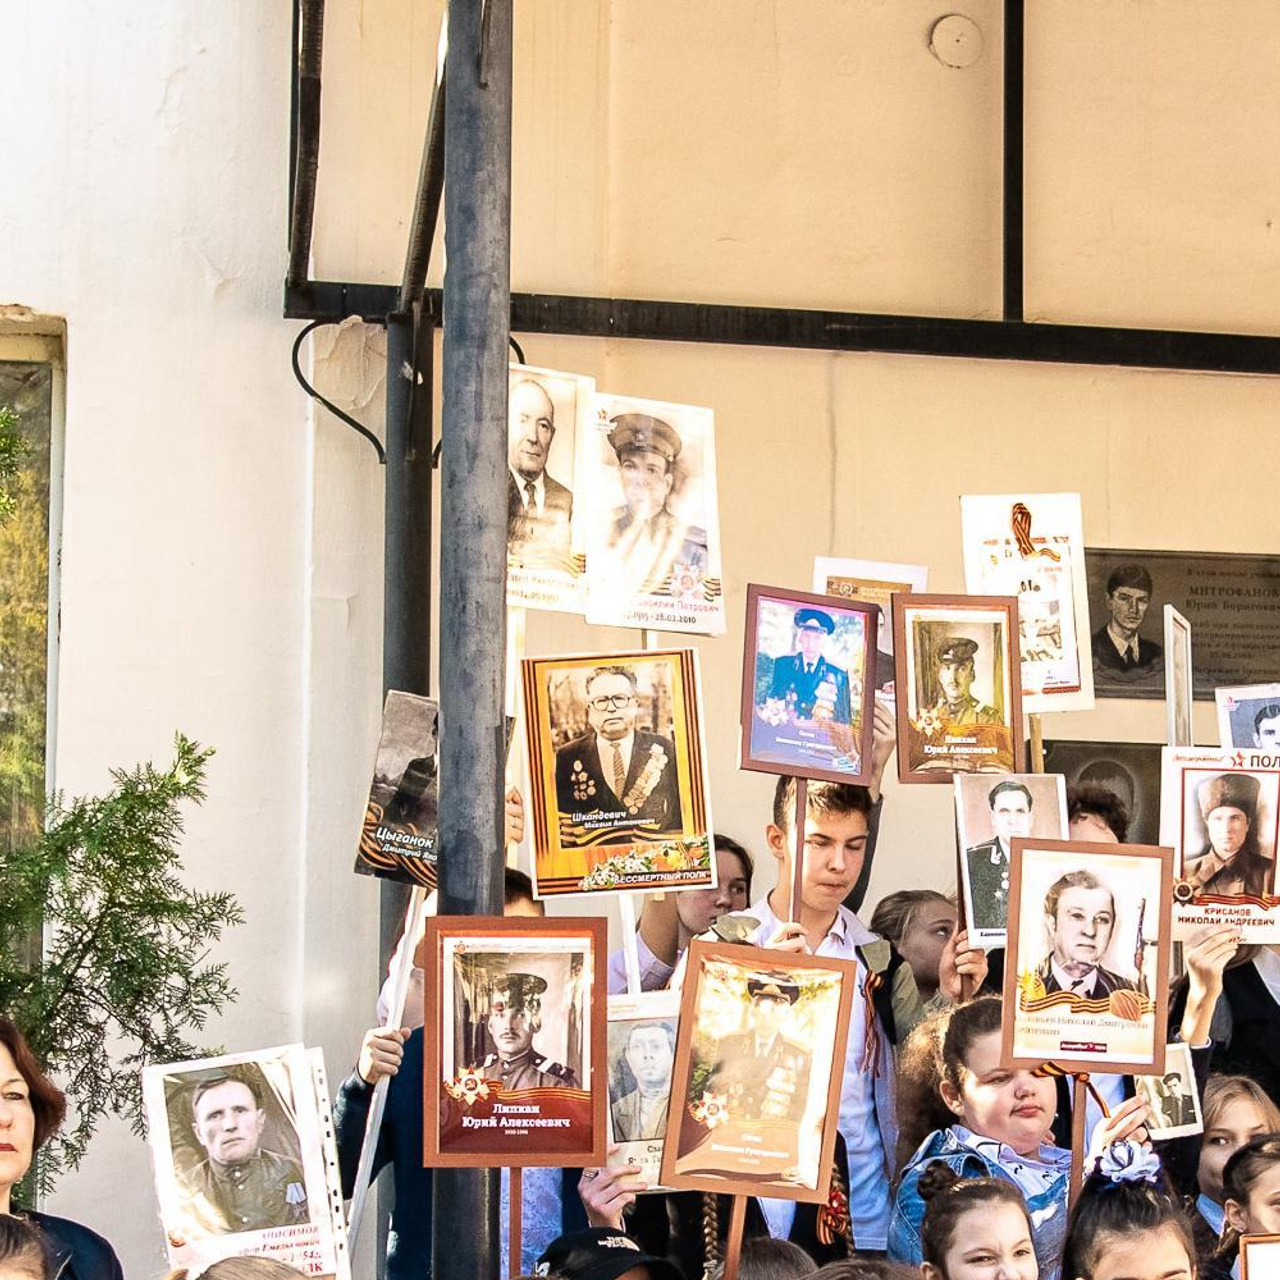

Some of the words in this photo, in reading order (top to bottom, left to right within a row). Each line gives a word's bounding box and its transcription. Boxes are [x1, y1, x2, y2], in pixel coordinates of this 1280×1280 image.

[1188, 586, 1280, 598] МИТРОФАНОВ
[676, 600, 720, 613] Петрович
[1185, 599, 1217, 612] Юрий
[572, 811, 627, 822] Шкандевич
[376, 827, 434, 848] Цыганок
[382, 844, 422, 857] Дмитрий
[1204, 907, 1252, 917] КРИСАНОВ
[1178, 916, 1221, 925] НИКОЛАЙ
[1224, 918, 1275, 926] АНДРЕЕВИЧ
[462, 1115, 498, 1128] Юрий
[499, 1116, 571, 1128] Алексеевич
